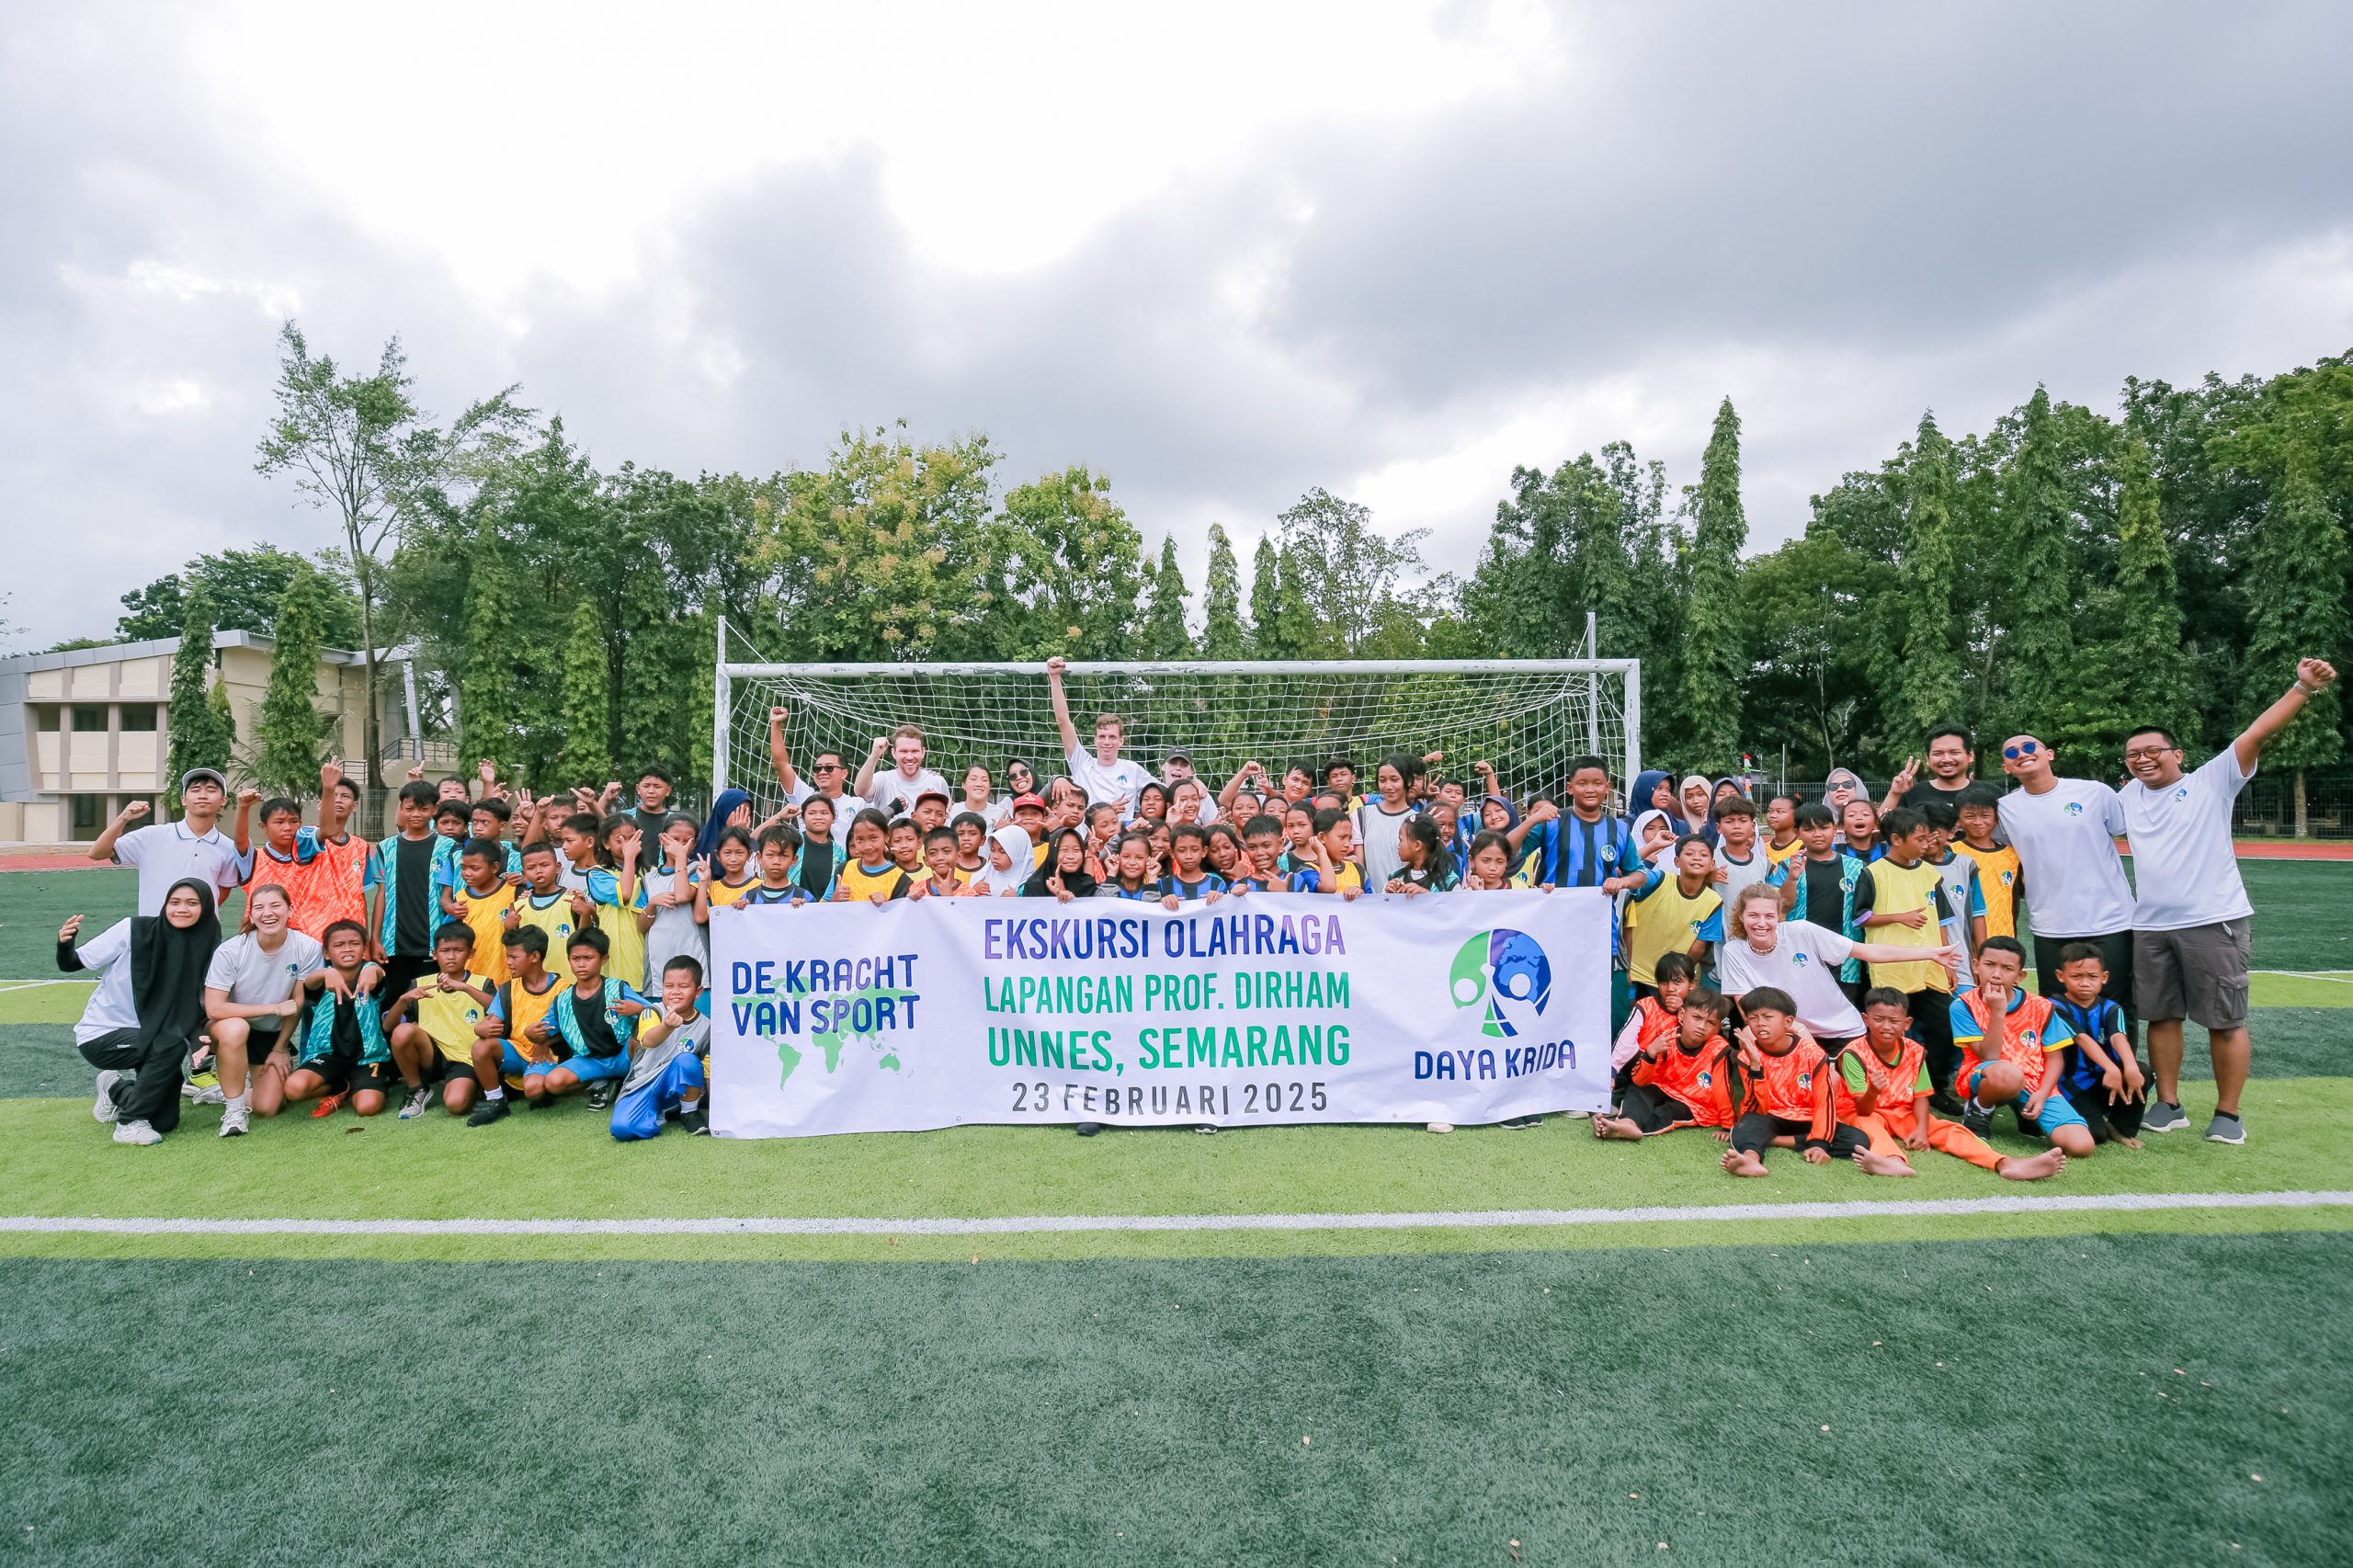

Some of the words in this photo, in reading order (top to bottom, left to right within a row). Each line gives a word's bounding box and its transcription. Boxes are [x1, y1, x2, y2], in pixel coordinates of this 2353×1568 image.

[984, 918, 1150, 960] EKSKURSI
[1165, 914, 1347, 959] OLAHRAGA
[733, 961, 778, 995] DE
[786, 954, 919, 994] KRACHT
[984, 975, 1134, 1015] LAPANGAN
[1145, 972, 1225, 1013] PROF.
[1235, 971, 1351, 1012] DIRHAM
[732, 1000, 801, 1037] VAN
[811, 994, 921, 1035] SPORT
[369, 1062, 380, 1077] 7
[988, 1027, 1125, 1078] UNNES,
[1139, 1025, 1351, 1070] SEMARANG
[1415, 1050, 1495, 1082] DAYA
[1505, 1039, 1577, 1078] KRIDA
[1012, 1082, 1050, 1113] 23
[1063, 1083, 1230, 1116] FEBRUARI
[1244, 1082, 1328, 1114] 2025
